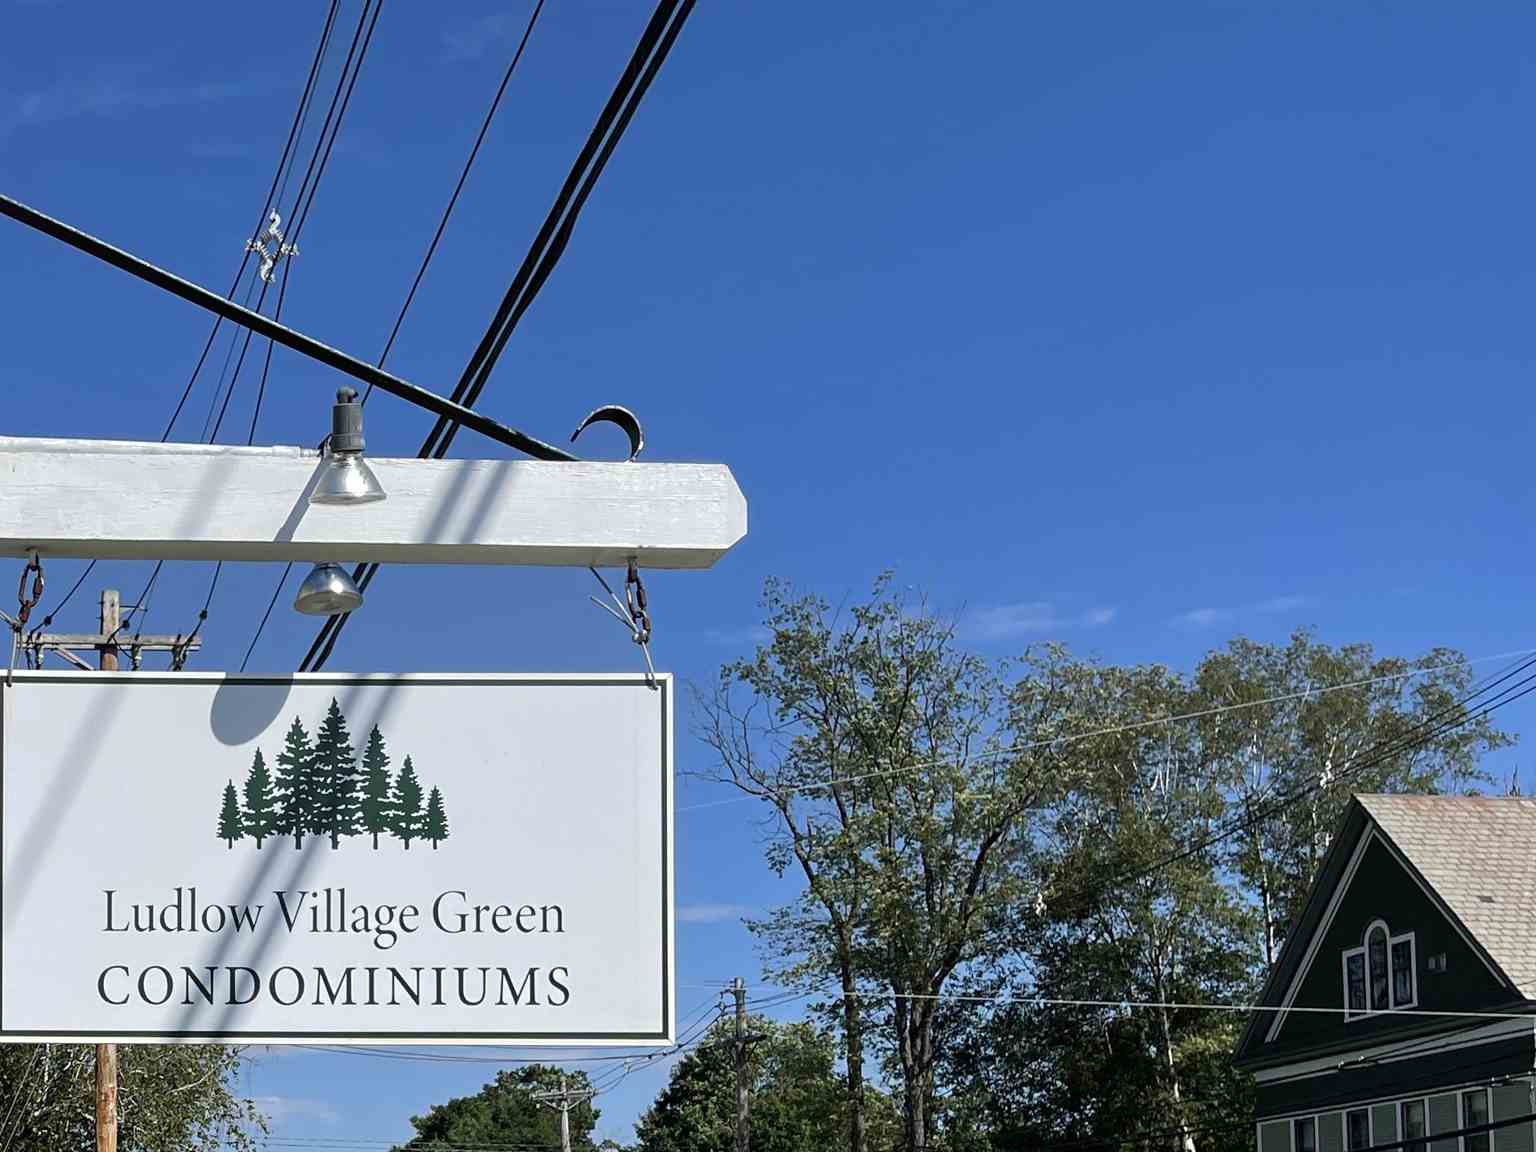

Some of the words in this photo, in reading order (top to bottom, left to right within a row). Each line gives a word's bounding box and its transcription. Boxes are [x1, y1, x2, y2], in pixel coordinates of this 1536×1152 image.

[102, 887, 264, 932] Ludlow
[272, 887, 419, 950] Village
[431, 890, 565, 933] Green
[97, 964, 571, 1006] CONDOMINIUMS
